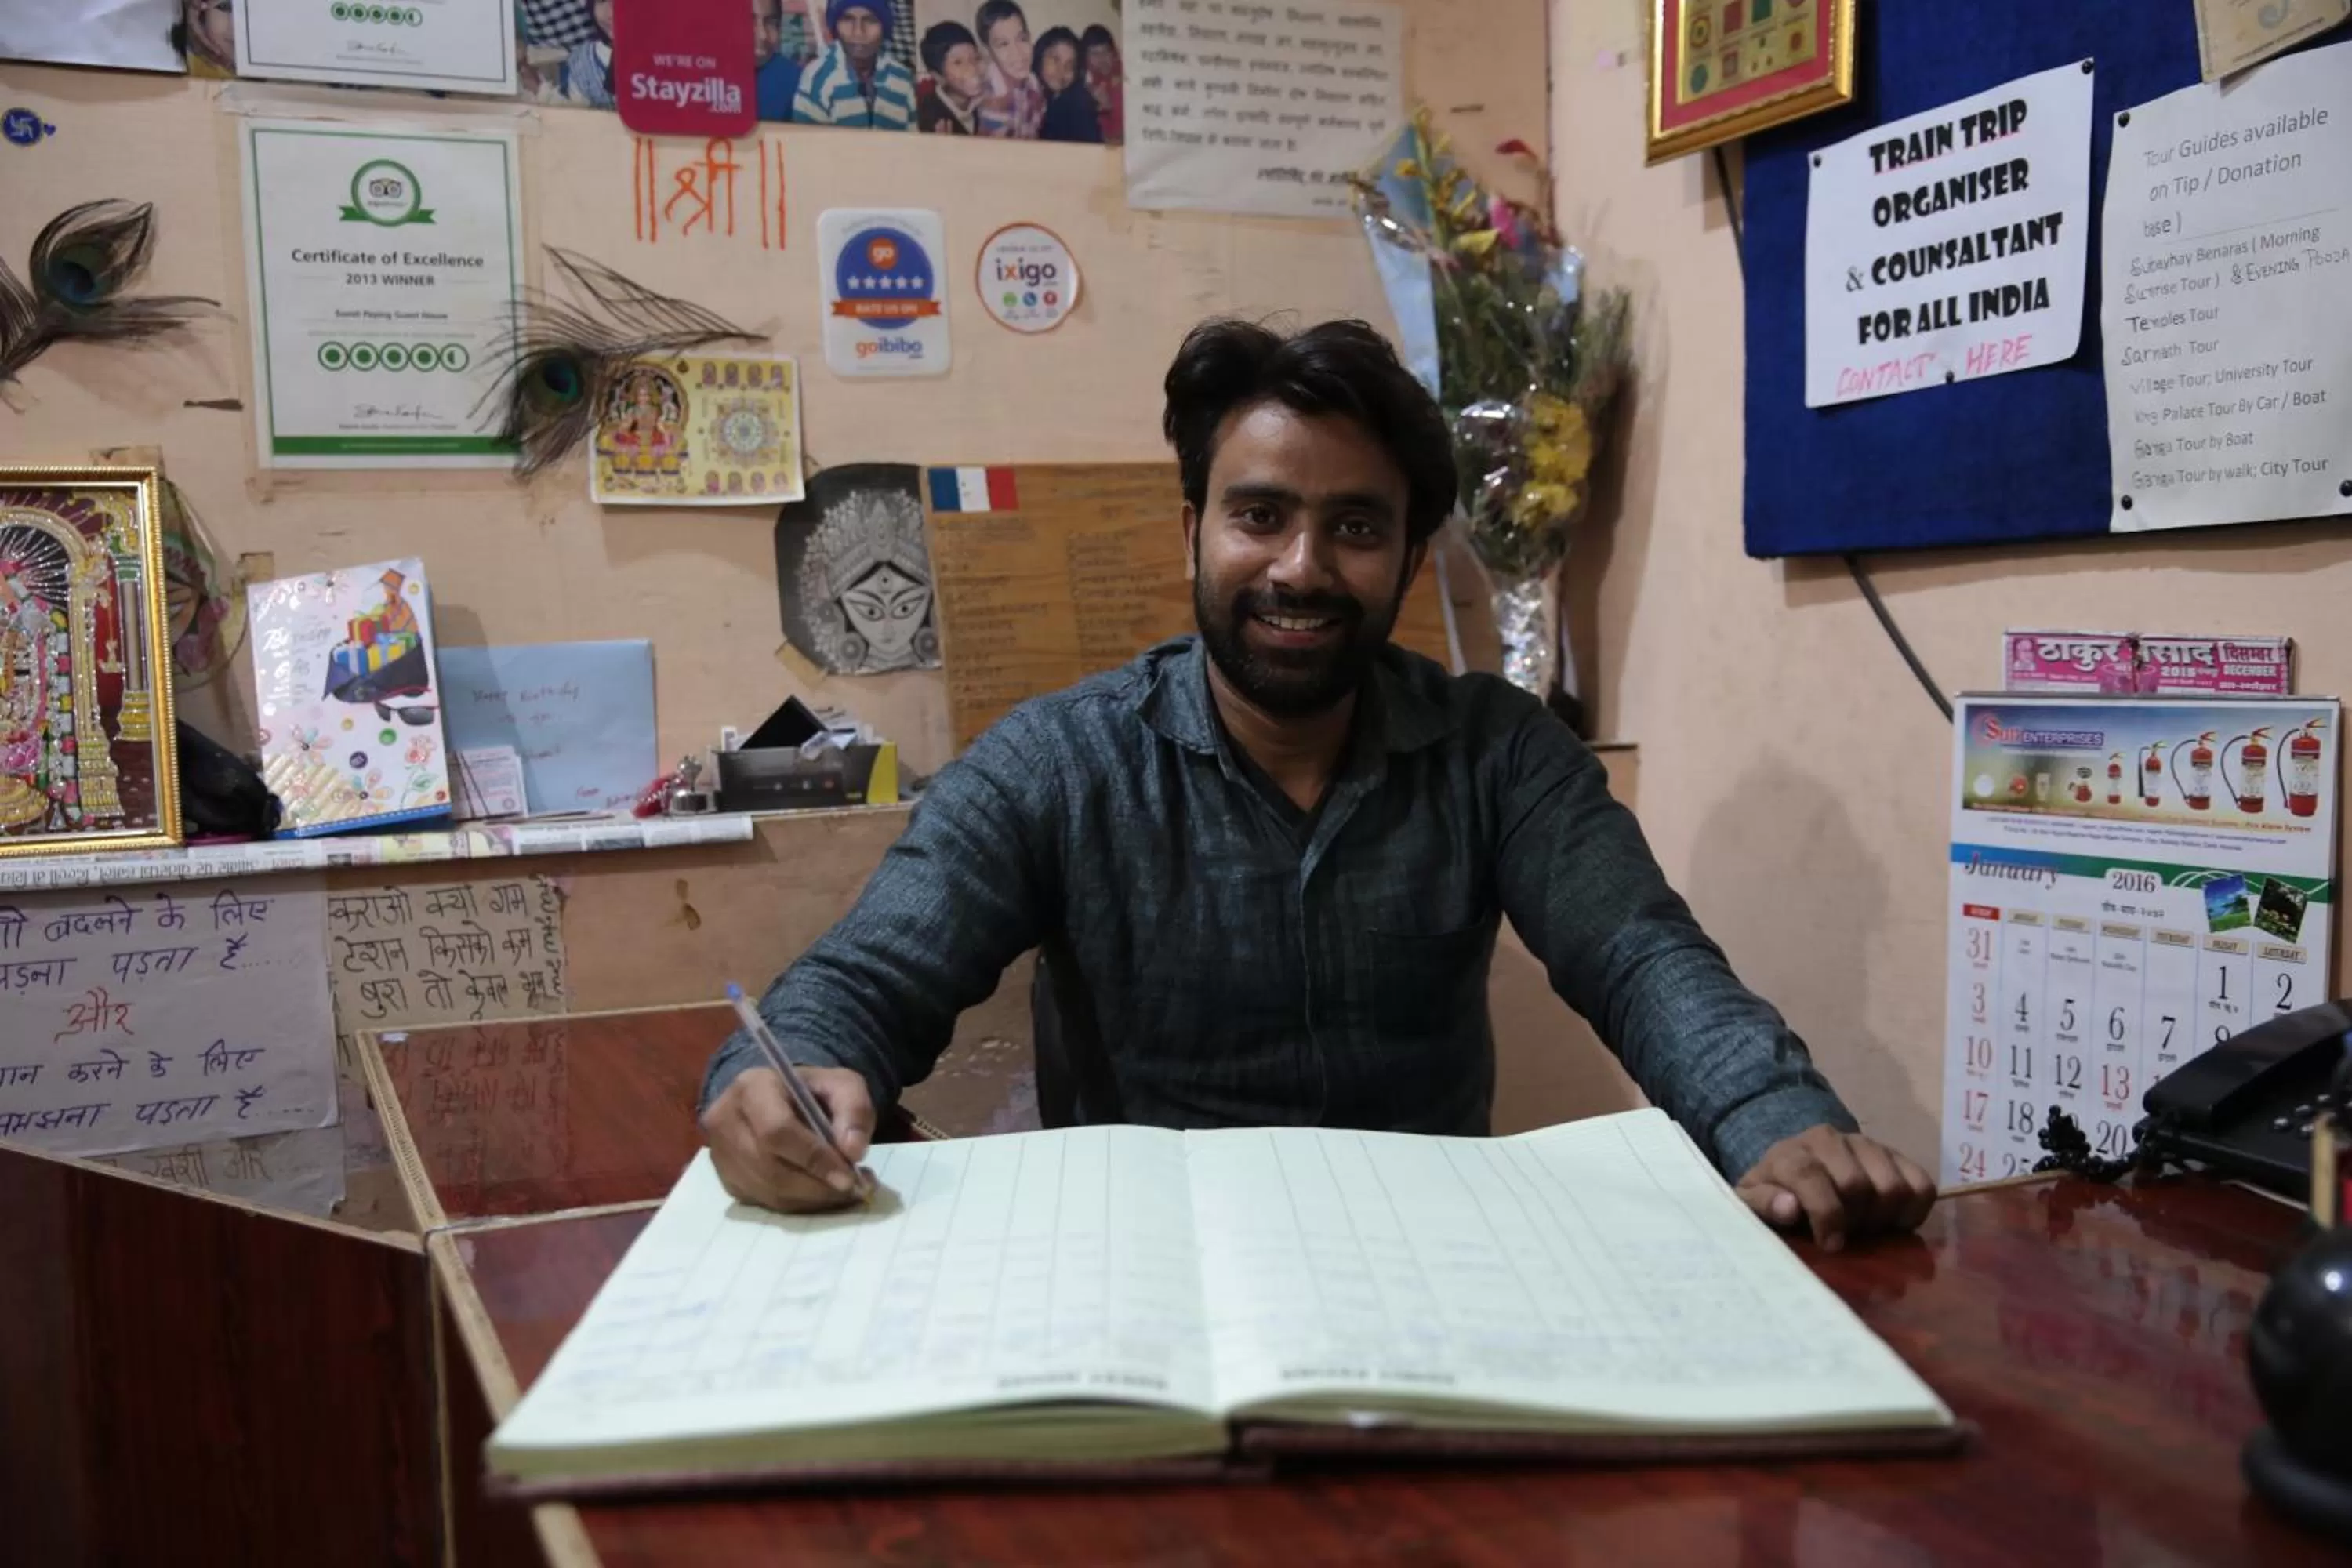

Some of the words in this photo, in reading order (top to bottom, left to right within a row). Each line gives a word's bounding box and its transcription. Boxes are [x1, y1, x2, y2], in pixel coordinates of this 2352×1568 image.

[652, 53, 692, 67] WE'RE
[696, 56, 716, 68] ON
[630, 73, 741, 107] Stayzilla
[1869, 122, 1953, 174] TRAIN
[1961, 99, 2027, 148] TRIP
[2179, 131, 2238, 158] Guides
[2244, 107, 2328, 143] available
[1872, 158, 2029, 227] ORGANISER
[2150, 183, 2168, 201] on
[2173, 176, 2199, 196] Tip
[2218, 153, 2302, 185] Donation
[291, 248, 376, 265] Certificate
[381, 250, 397, 265] of
[403, 252, 484, 267] Excellence
[1846, 266, 1864, 292] &
[1872, 212, 2063, 285] COUNSALTANT
[2197, 241, 2249, 262] Benaras
[2260, 227, 2321, 249] Morning
[346, 274, 377, 285] 2013
[382, 274, 435, 286] WINNER
[995, 256, 1056, 287] ixigo
[2180, 276, 2211, 291] Tour
[1858, 308, 1911, 345] FOR
[1917, 296, 1962, 333] ALL
[1969, 277, 2050, 323] INDIA
[2189, 307, 2220, 321] Tour
[855, 336, 924, 360] goibibo
[2189, 339, 2220, 354] Tour
[1835, 350, 1939, 398] CONTACT
[1965, 333, 2032, 376] HERE
[2215, 363, 2278, 383] University
[2282, 358, 2314, 374] Tour
[2162, 406, 2205, 421] Palace
[2208, 402, 2237, 417] Tour
[2256, 395, 2279, 410] Car
[2292, 390, 2327, 406] Boat
[2176, 437, 2206, 452] Tour
[2226, 431, 2254, 447] Boat
[2177, 468, 2207, 483] Tour
[2260, 461, 2288, 477] City
[2292, 458, 2330, 474] Tour
[2038, 639, 2122, 671] ठाकुर
[1965, 852, 2058, 890] January
[2112, 872, 2156, 893] 2016
[45, 895, 143, 942] बदलने
[156, 893, 185, 931] के
[209, 890, 269, 931] लिए
[112, 946, 199, 985] पड़ता
[1966, 927, 1991, 961] 31
[2219, 965, 2228, 1000] 1
[2277, 973, 2293, 1011] 2
[417, 968, 454, 1010] तो
[54, 987, 134, 1043] और
[1973, 982, 1986, 1014] 3
[2015, 992, 2029, 1022] 4
[2060, 998, 2076, 1031] 5
[2108, 1007, 2125, 1040] 6
[2161, 1016, 2176, 1050] 7
[1965, 1036, 1992, 1069] 10
[2010, 1044, 2032, 1080] 11
[2055, 1054, 2082, 1089] 12
[2102, 1064, 2130, 1100] 13
[1965, 1090, 1989, 1122] 17
[2008, 1100, 2034, 1134] 18
[2096, 1120, 2128, 1160] 20
[1959, 1143, 1985, 1178] 24
